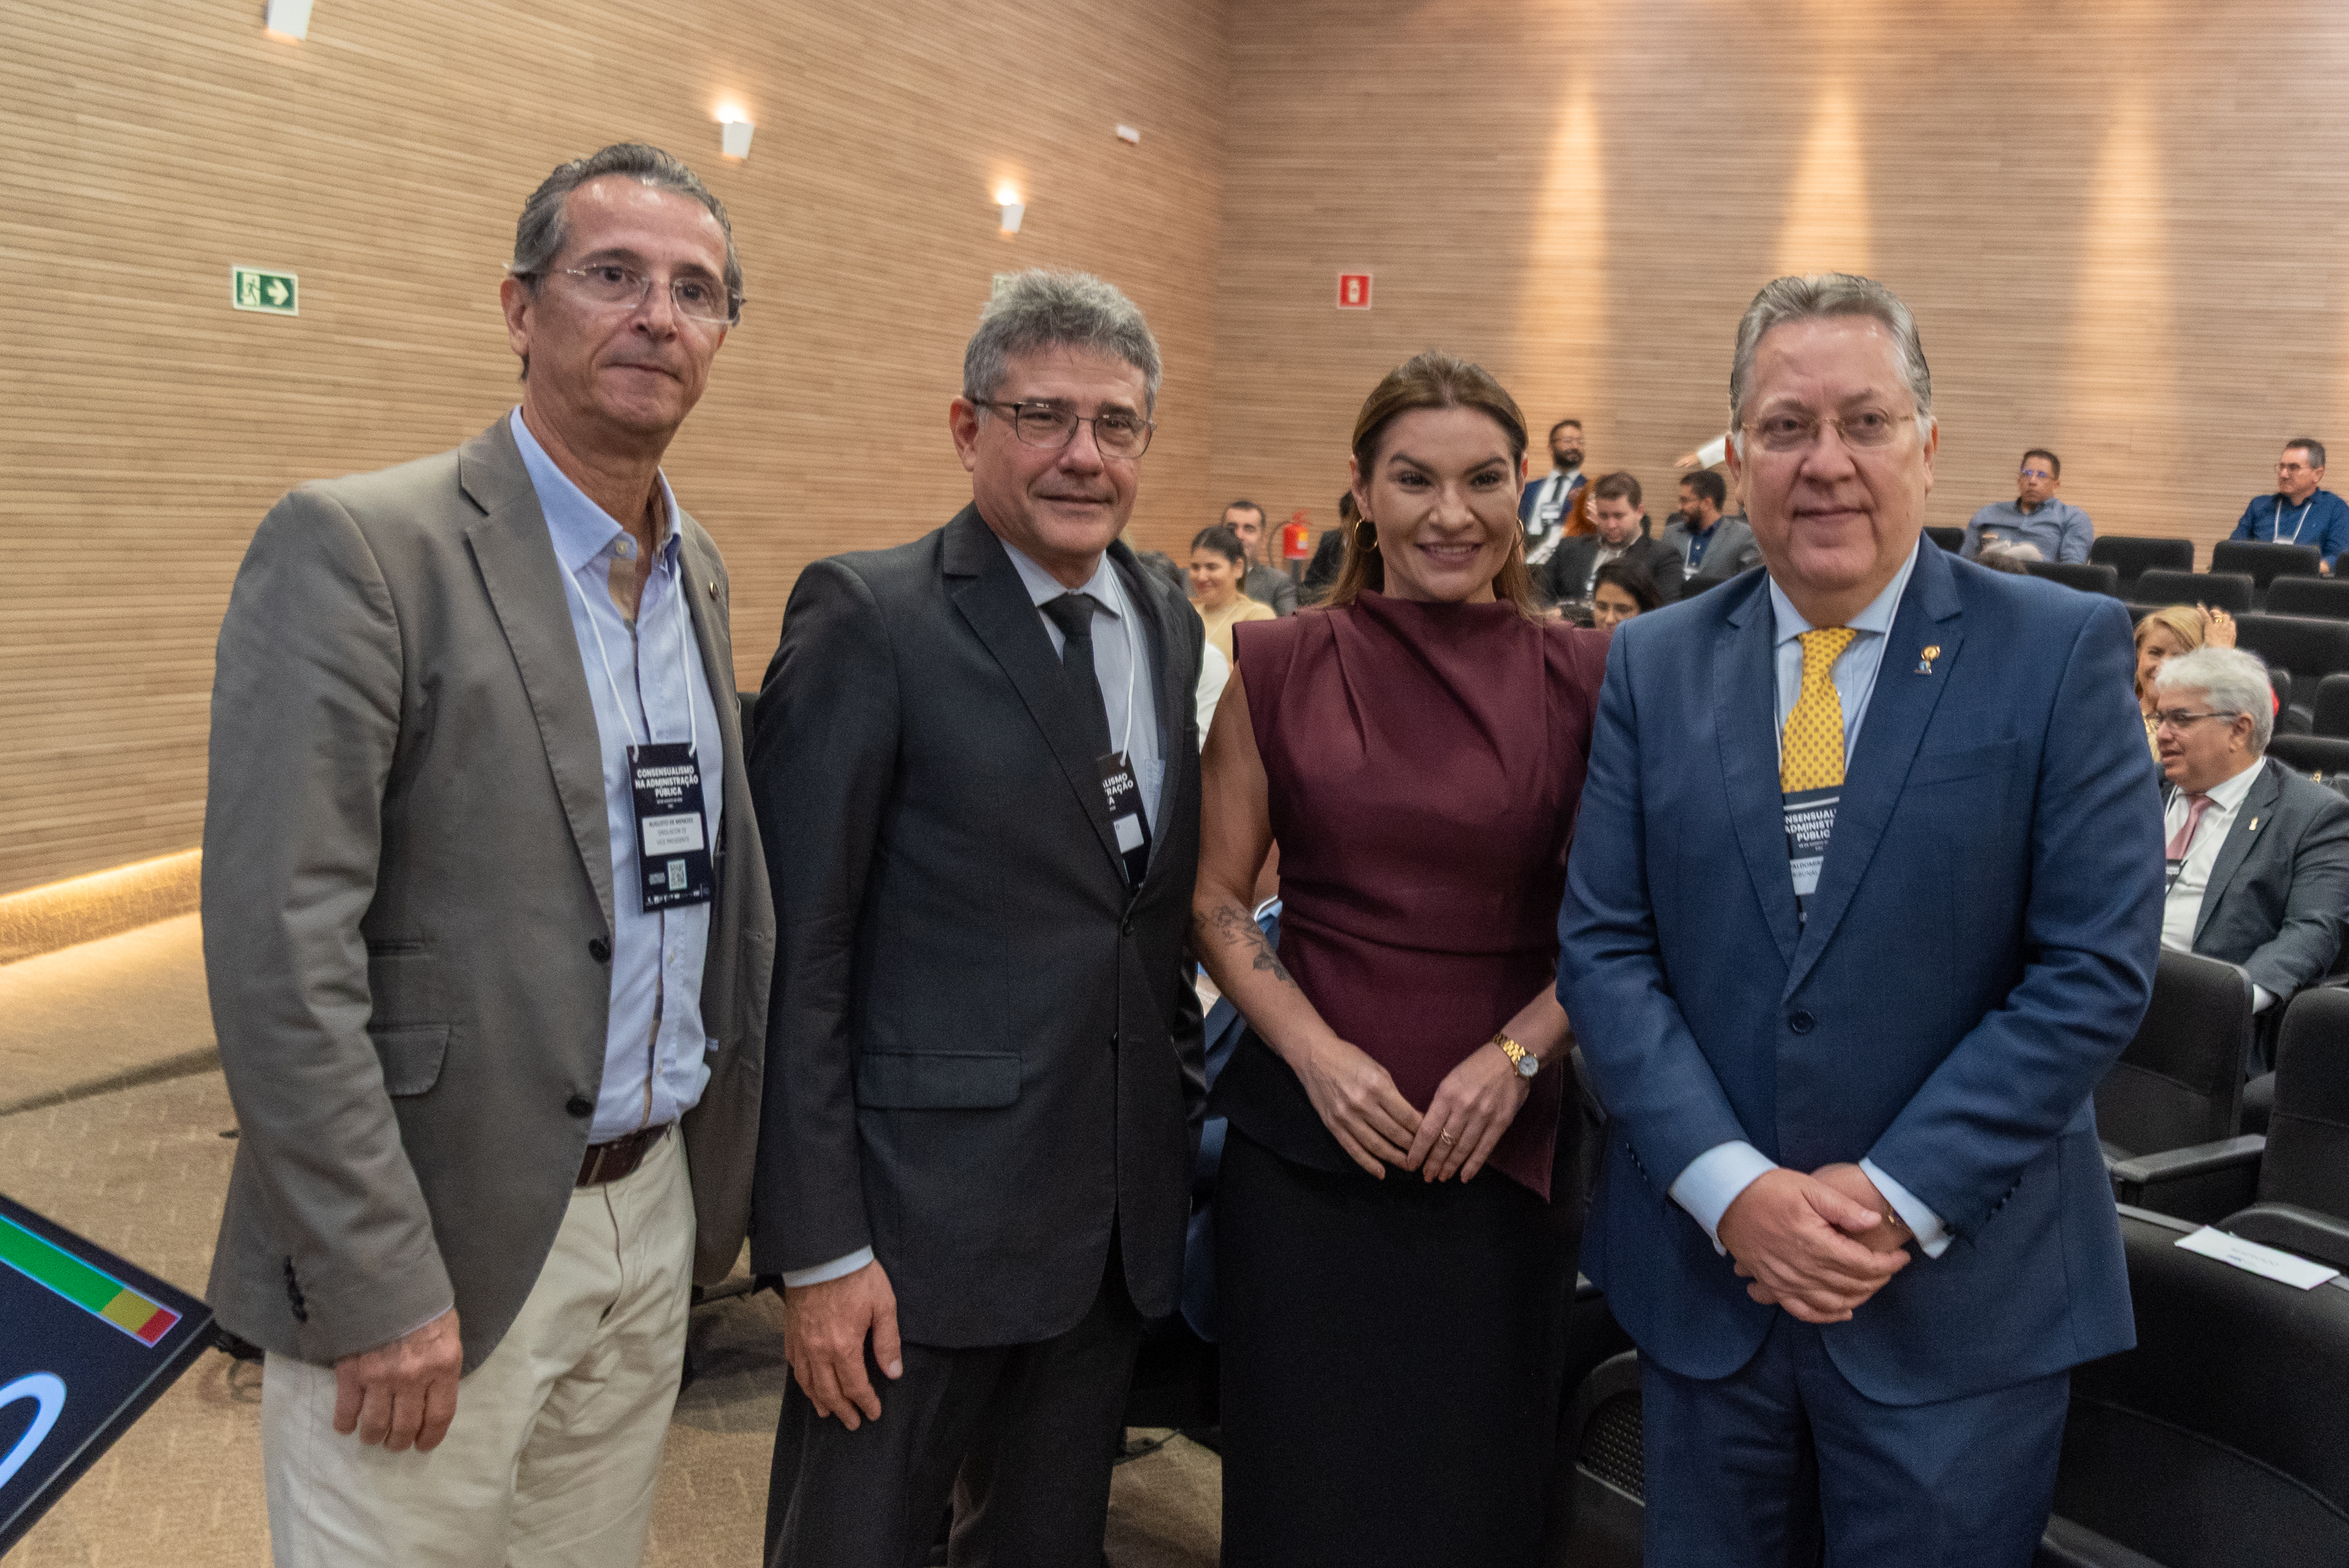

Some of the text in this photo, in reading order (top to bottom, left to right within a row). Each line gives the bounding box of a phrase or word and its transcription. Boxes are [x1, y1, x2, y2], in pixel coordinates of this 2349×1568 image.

[637, 765, 694, 779] CONSENSUALISMO
[635, 774, 698, 789] NA ADMINISTRAÇÃO
[1105, 778, 1133, 796] RAÇÃO
